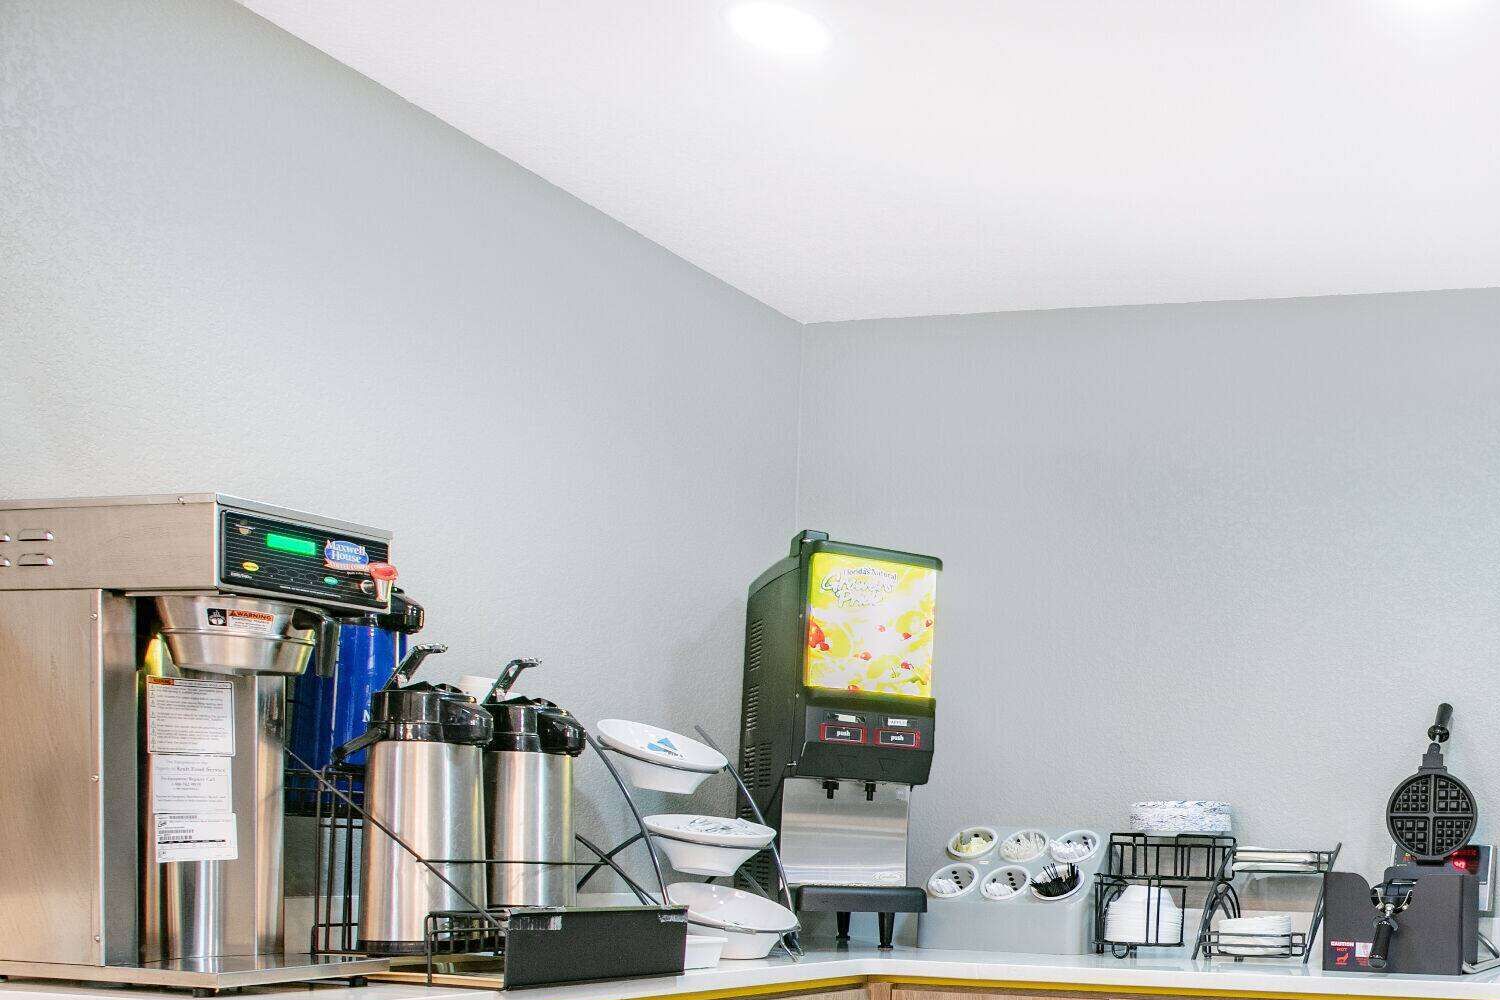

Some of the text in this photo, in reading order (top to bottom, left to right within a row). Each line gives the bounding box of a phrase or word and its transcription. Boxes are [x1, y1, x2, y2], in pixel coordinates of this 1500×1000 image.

[329, 541, 368, 557] Maxwell
[331, 549, 362, 563] House
[236, 610, 273, 621] WARNING
[836, 729, 851, 738] push
[890, 734, 905, 742] push
